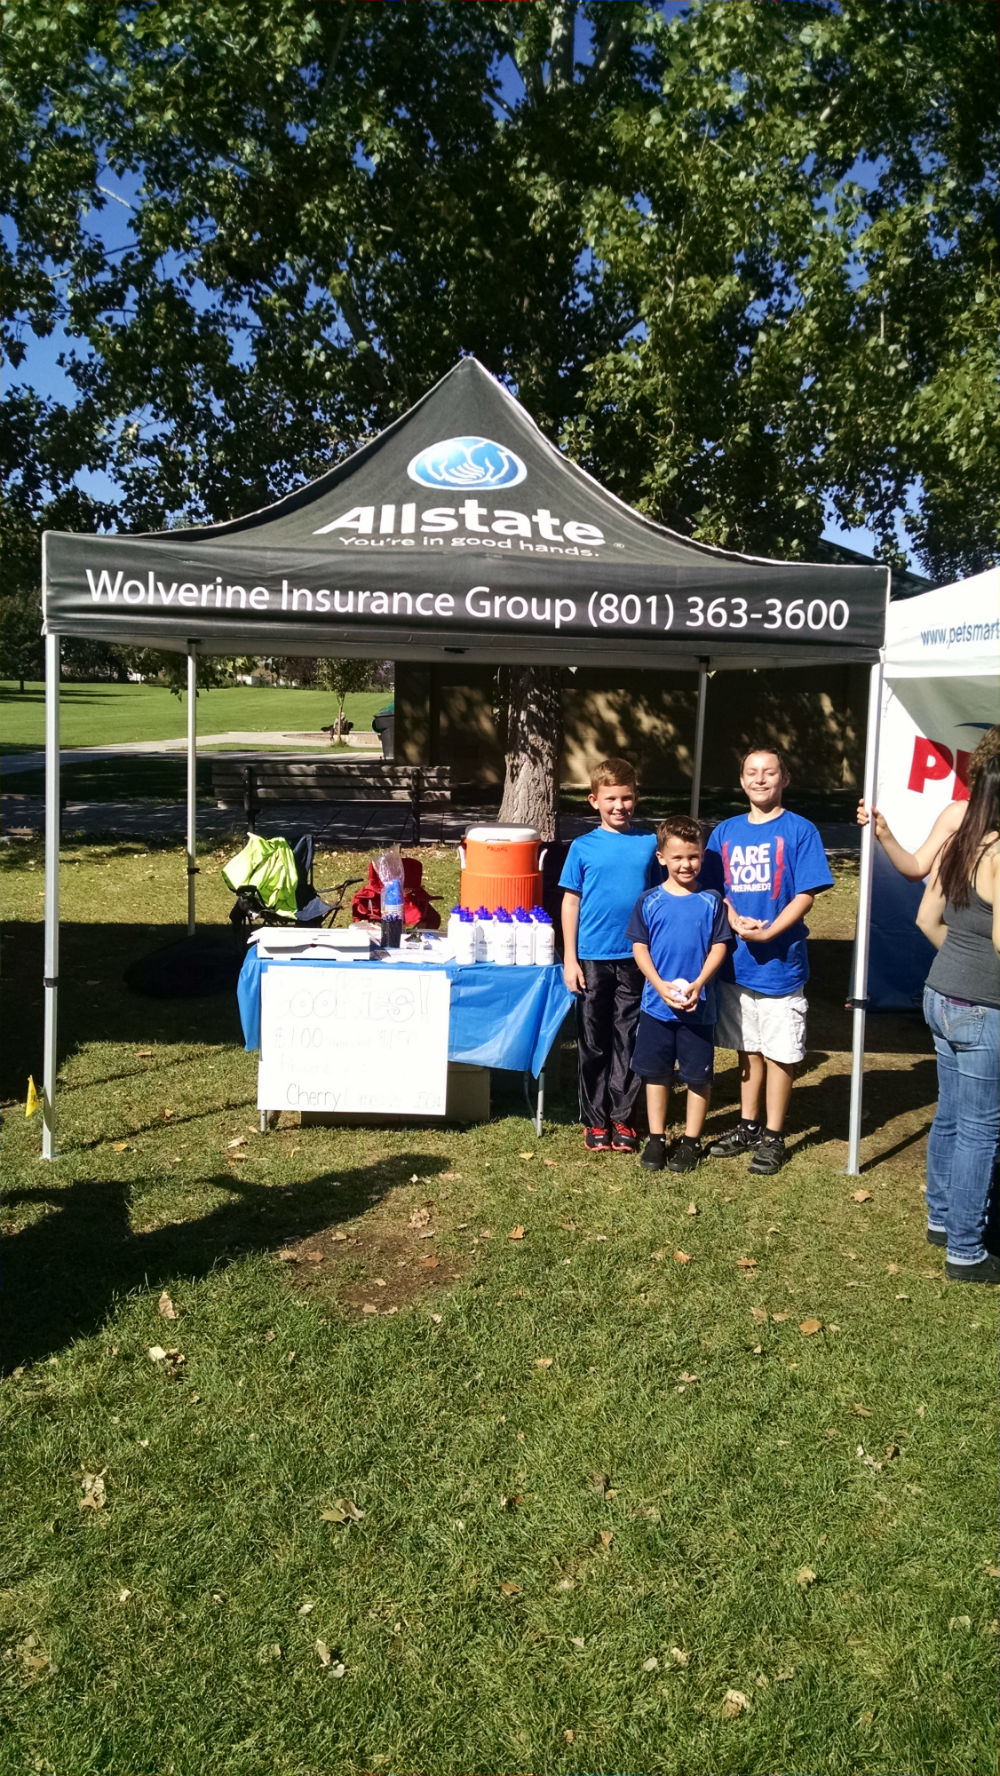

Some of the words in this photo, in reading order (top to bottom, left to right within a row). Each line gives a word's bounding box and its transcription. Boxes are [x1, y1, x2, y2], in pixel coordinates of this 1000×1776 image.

[312, 499, 606, 546] Allstate
[339, 536, 415, 547] You're
[423, 536, 443, 546] in
[450, 537, 511, 549] good
[519, 539, 600, 557] hands.
[85, 568, 269, 611] Wolverine
[281, 579, 455, 617] Insurance
[465, 586, 577, 628] Group
[587, 590, 674, 631] (801)
[685, 596, 850, 631] 363-3600
[729, 843, 771, 867] ARE
[729, 863, 771, 884] YOU
[731, 882, 771, 893] PREPARED?
[286, 1082, 342, 1112] Cherry
